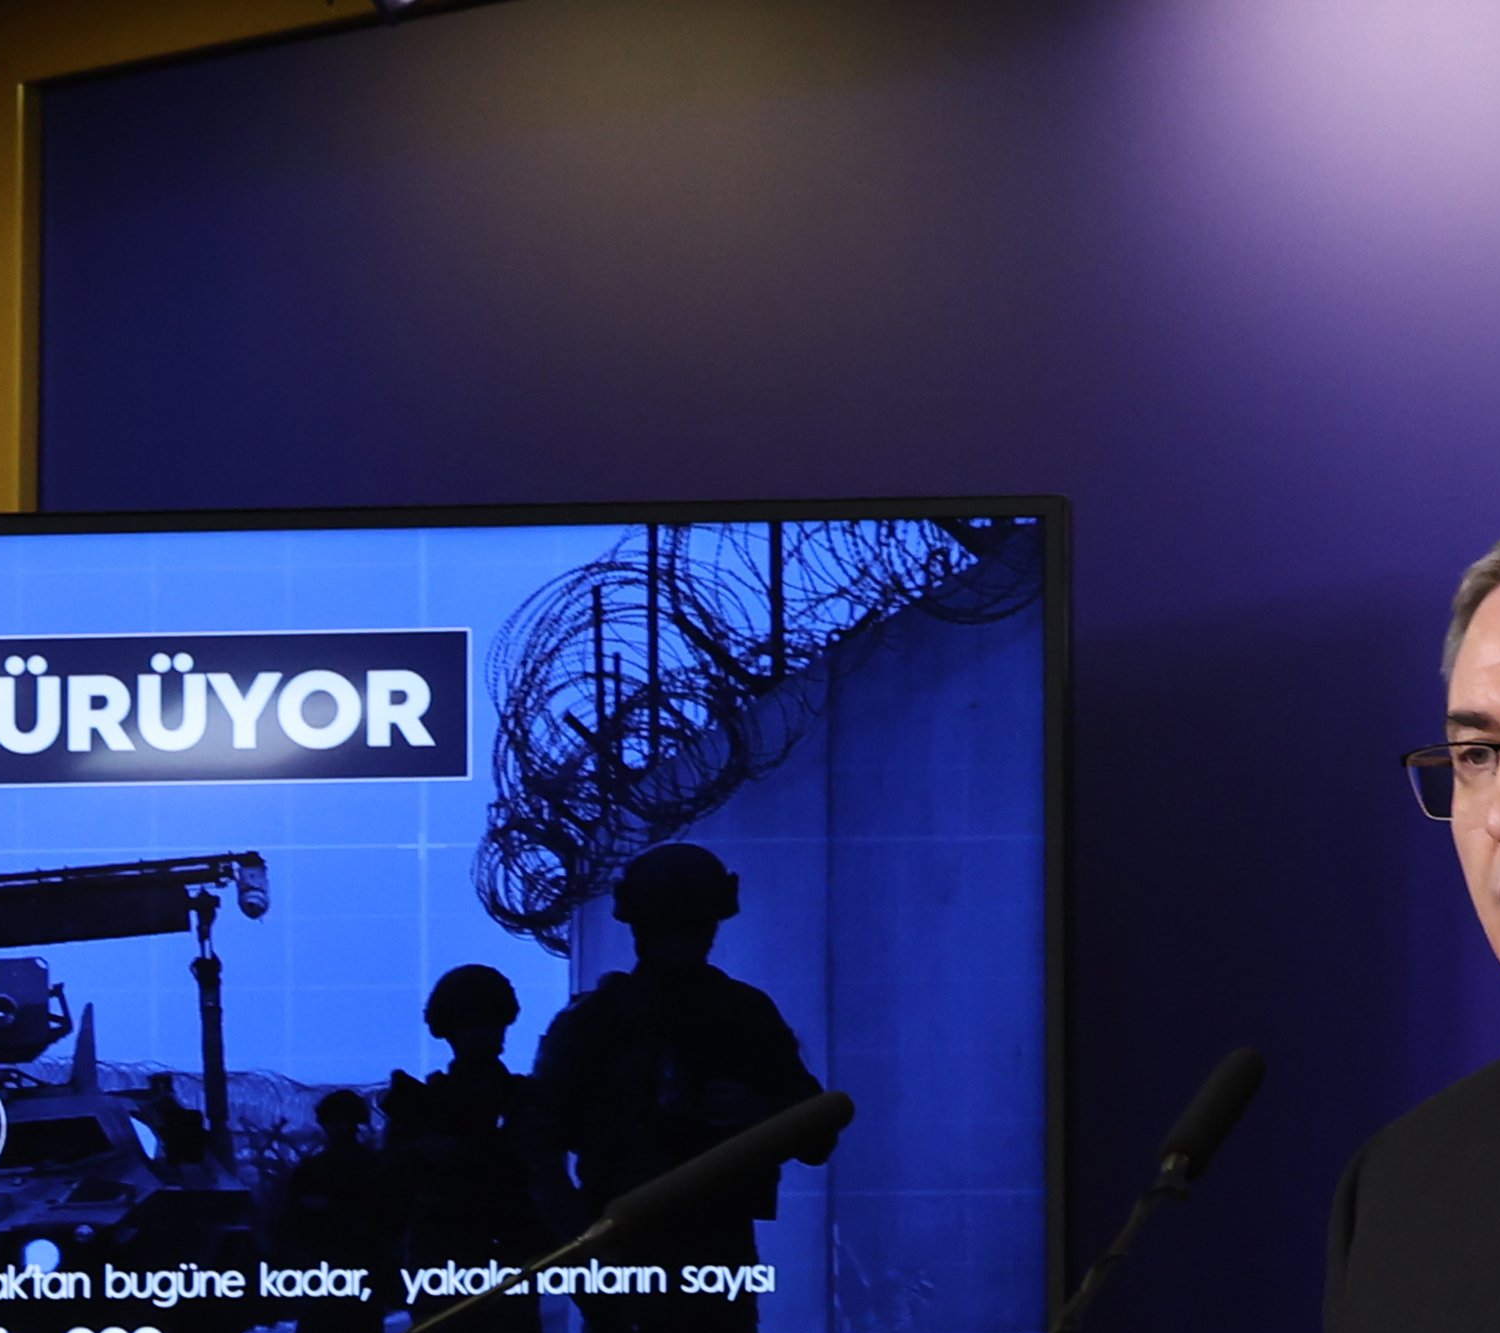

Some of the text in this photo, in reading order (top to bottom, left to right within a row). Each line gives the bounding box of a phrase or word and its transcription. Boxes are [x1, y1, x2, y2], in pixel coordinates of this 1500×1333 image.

[104, 1262, 246, 1308] bugüne
[259, 1260, 372, 1302] kadar,
[680, 1264, 776, 1302] sayısı
